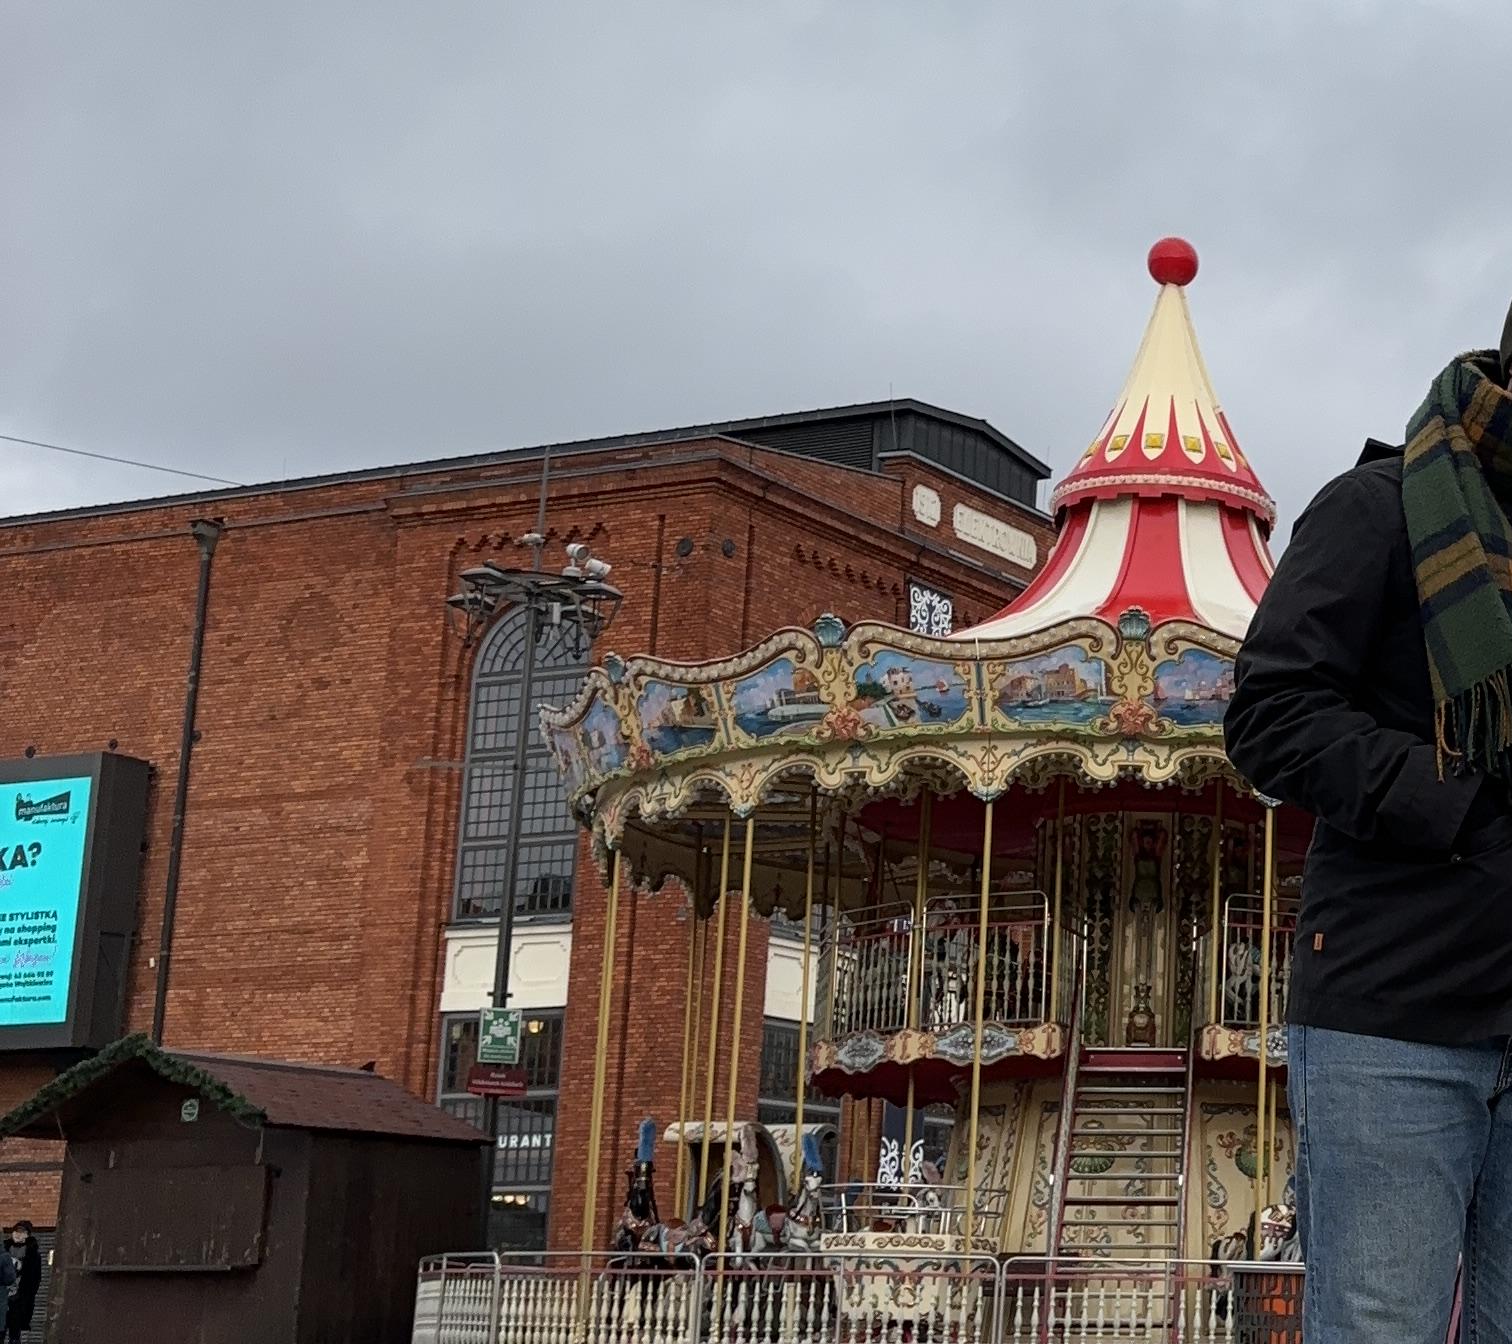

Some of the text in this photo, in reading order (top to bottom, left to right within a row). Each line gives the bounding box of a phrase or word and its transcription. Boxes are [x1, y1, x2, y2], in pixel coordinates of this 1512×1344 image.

[18, 801, 68, 816] manufaktura
[9, 910, 57, 921] STYLISTKĄ
[17, 922, 57, 934] shopping
